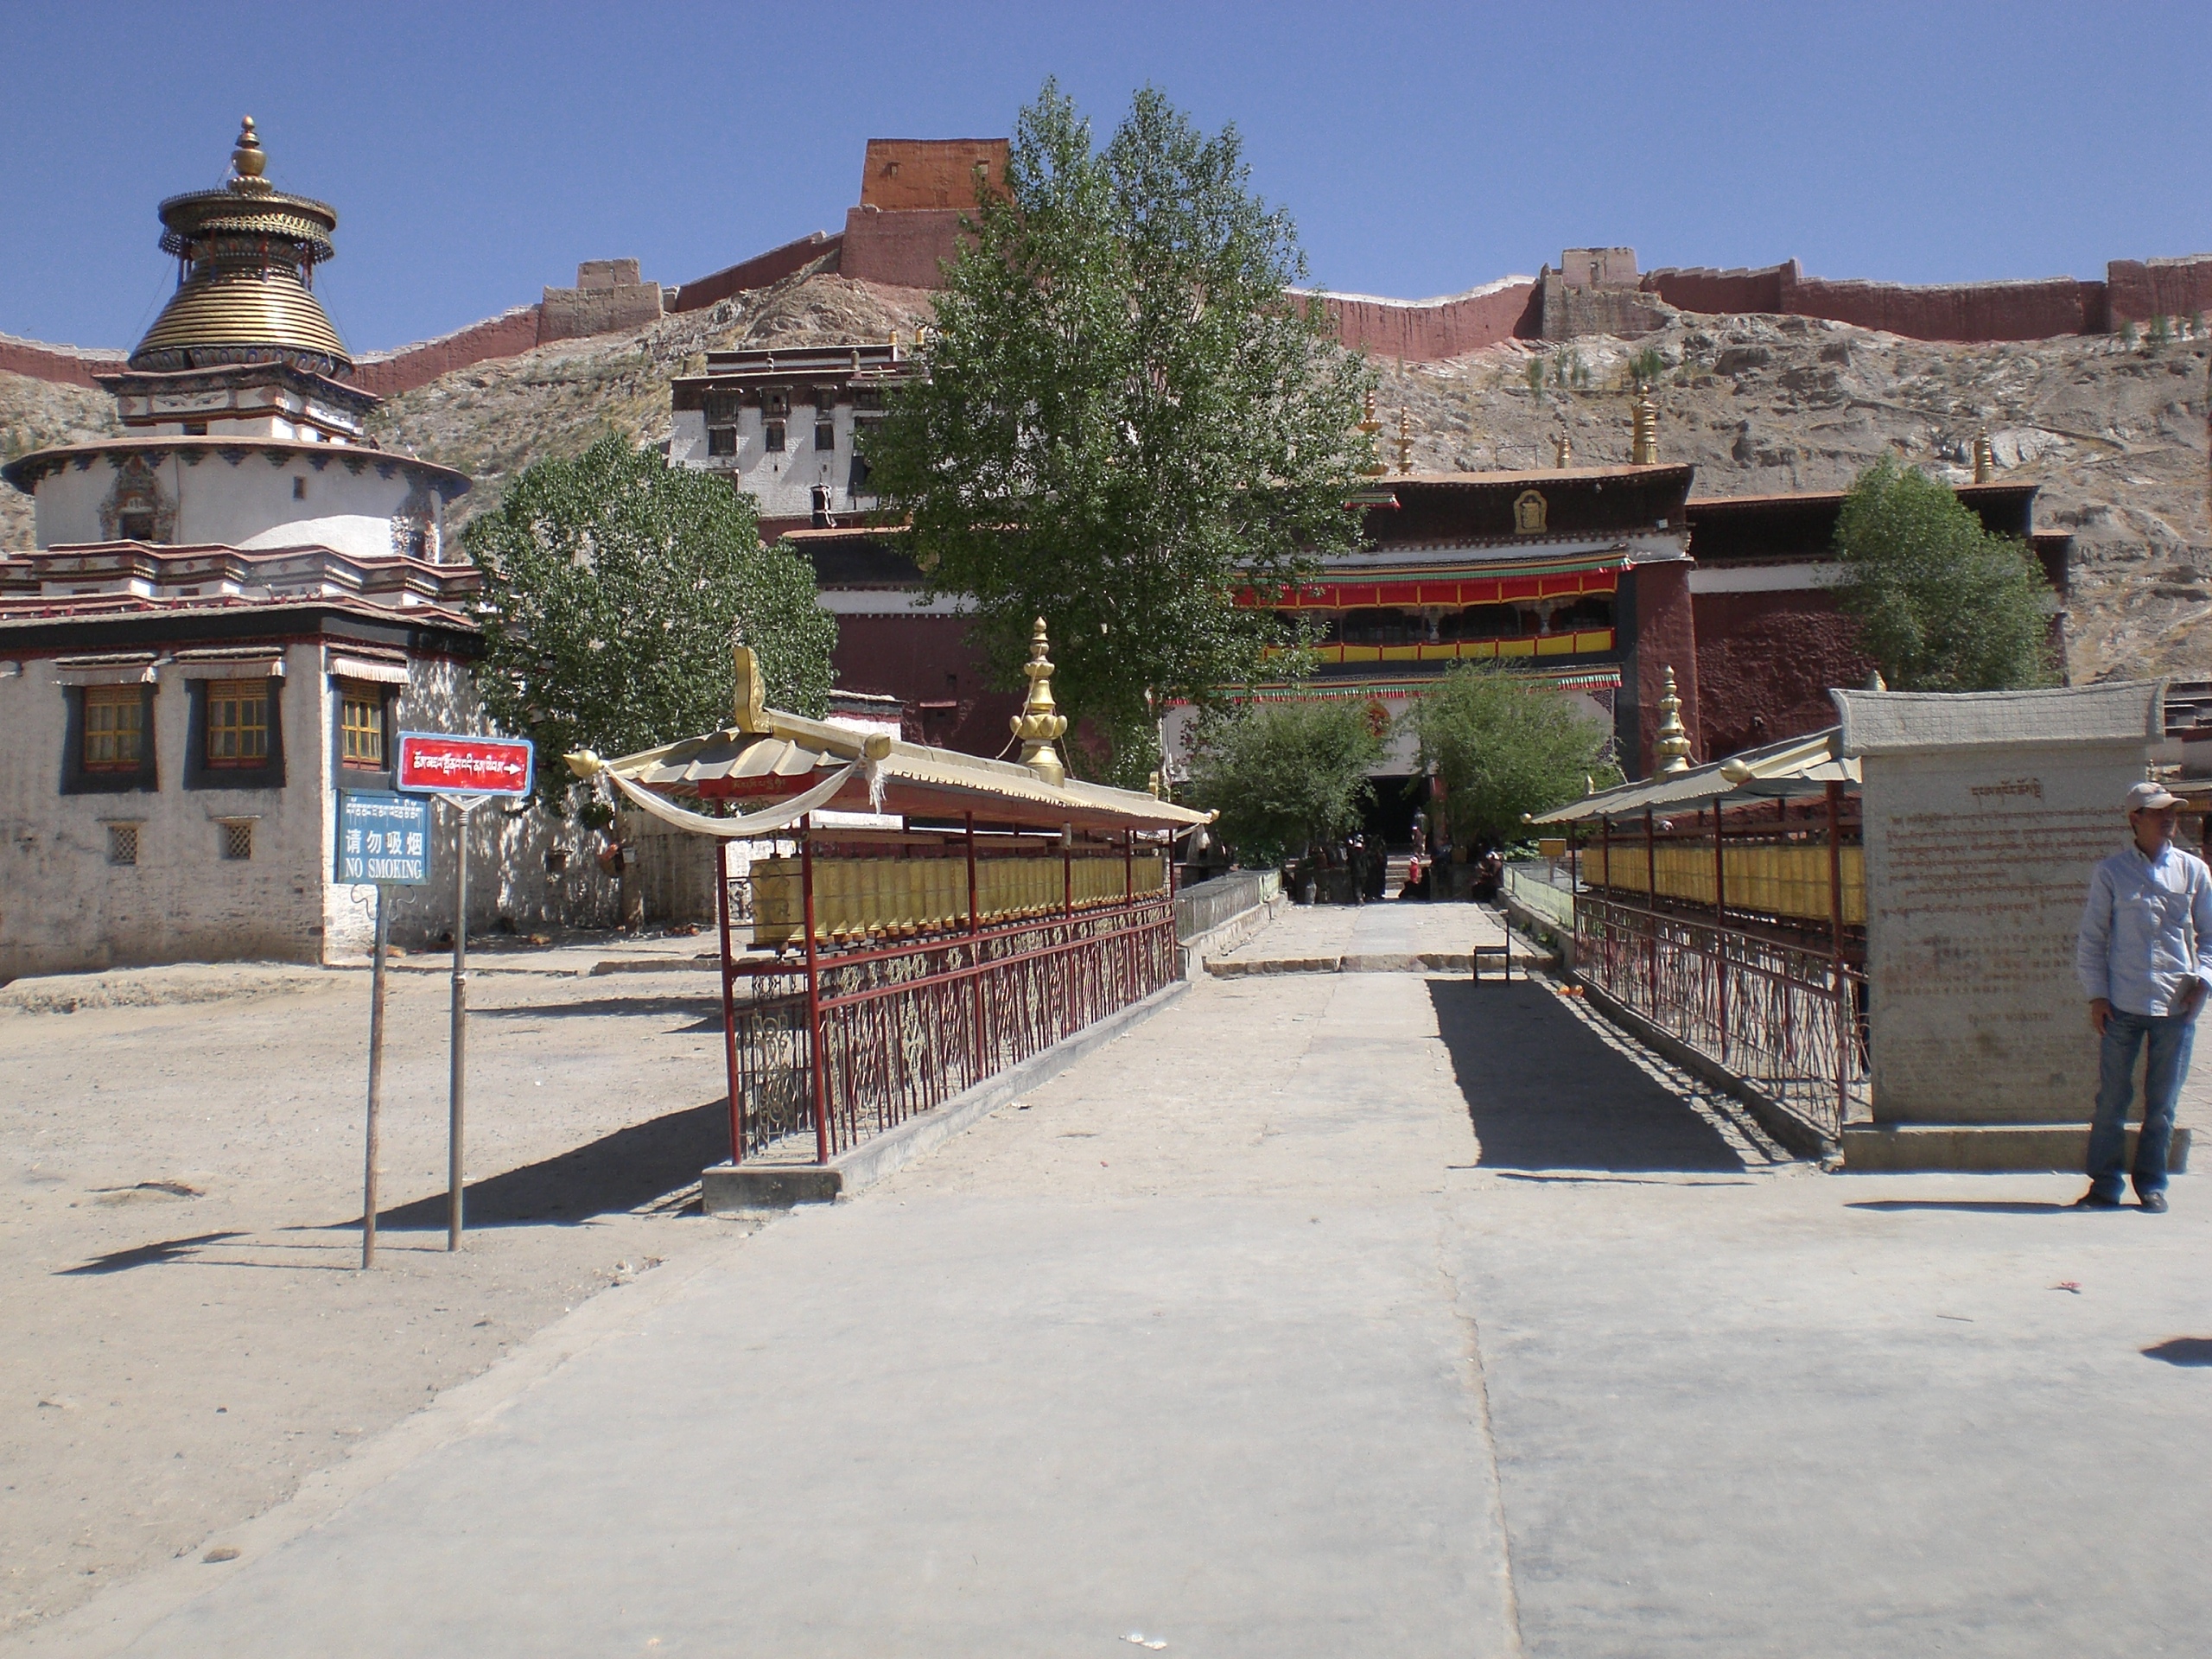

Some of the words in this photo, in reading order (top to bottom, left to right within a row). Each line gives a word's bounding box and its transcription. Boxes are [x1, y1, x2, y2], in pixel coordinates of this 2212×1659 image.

[345, 828, 423, 855] 请勿吸烟
[345, 857, 363, 878] NO
[368, 857, 423, 880] SMOKING
